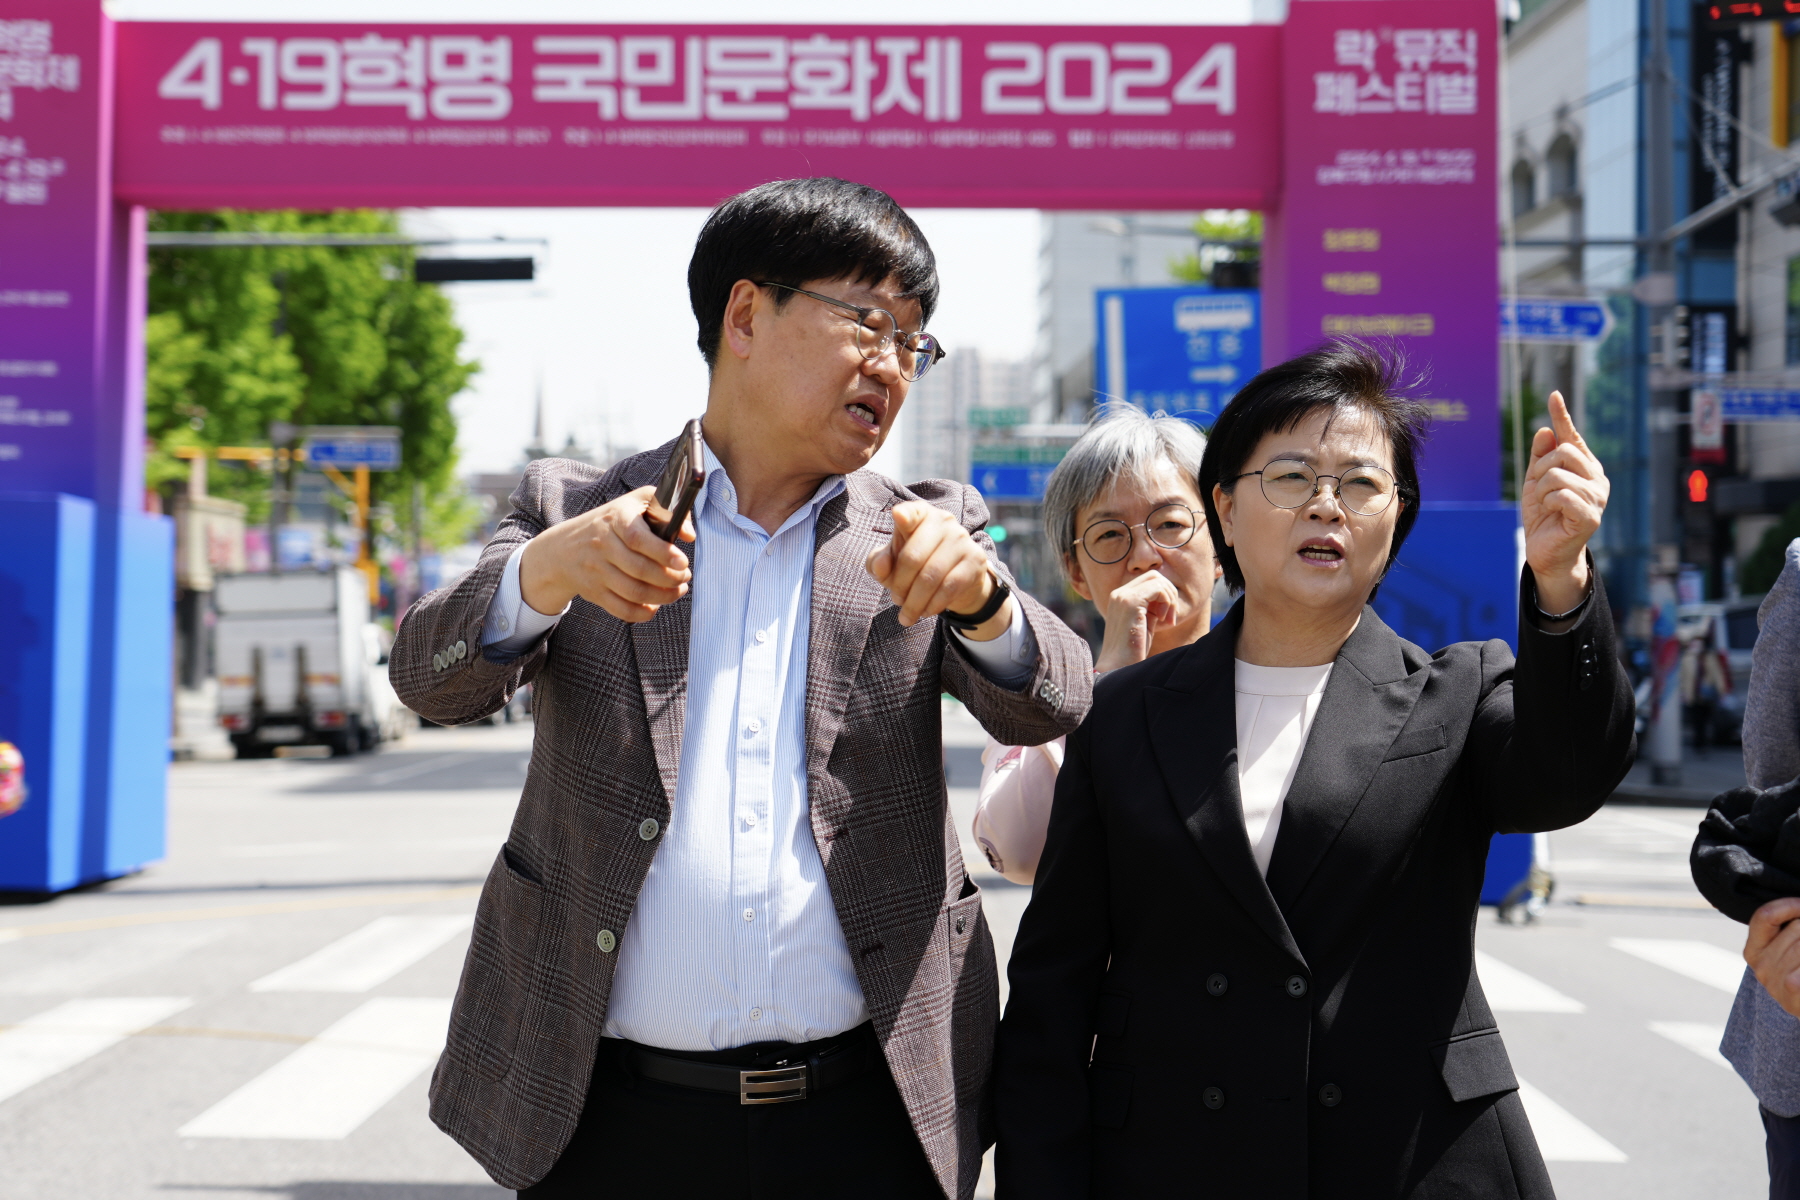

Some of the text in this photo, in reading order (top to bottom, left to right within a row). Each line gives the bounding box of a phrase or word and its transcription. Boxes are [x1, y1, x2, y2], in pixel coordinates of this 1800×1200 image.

[533, 34, 961, 121] 국민문화제
[982, 42, 1235, 114] 2024
[1314, 72, 1478, 115] 페스티벌
